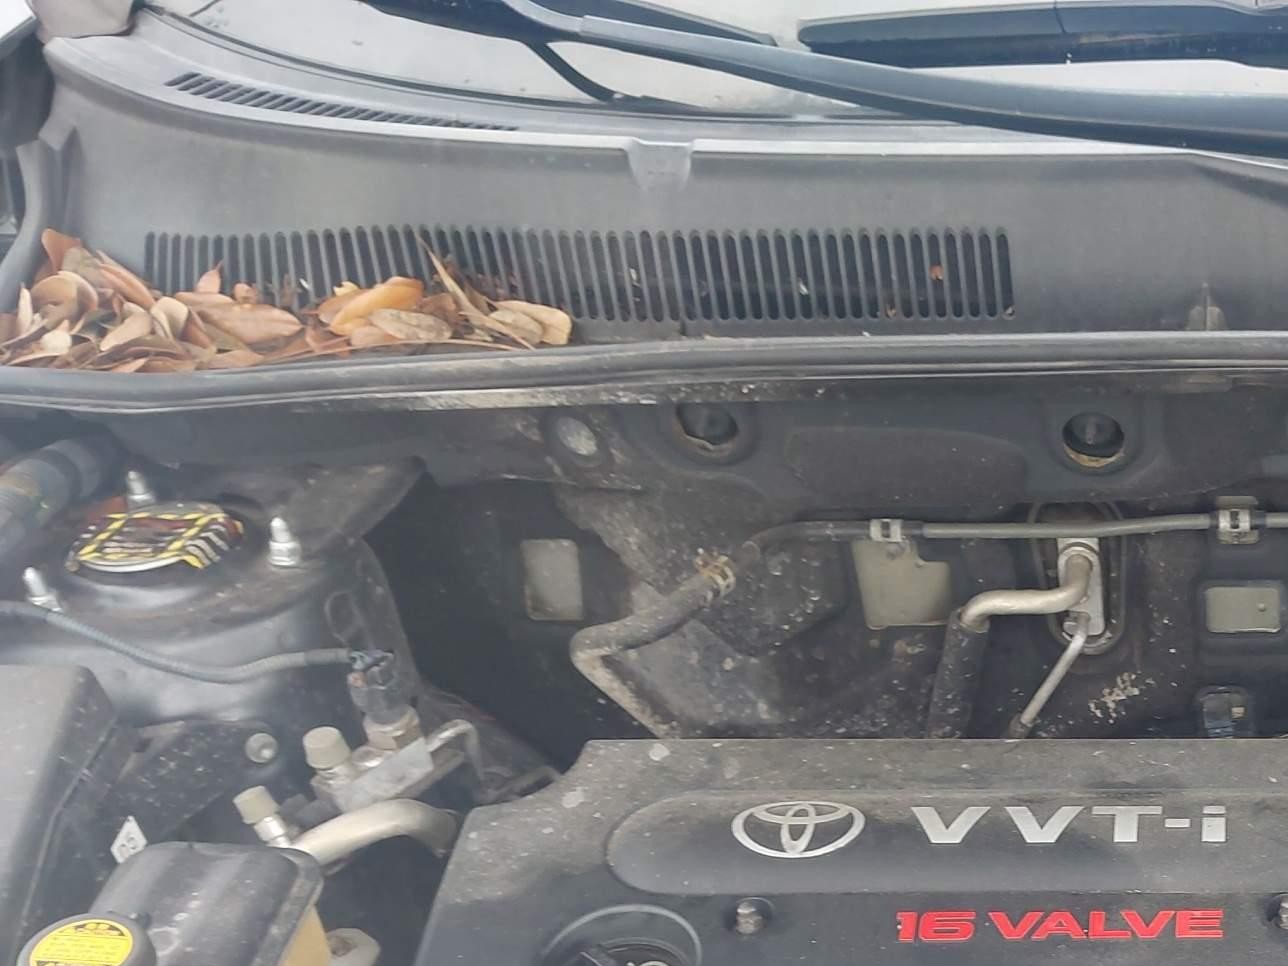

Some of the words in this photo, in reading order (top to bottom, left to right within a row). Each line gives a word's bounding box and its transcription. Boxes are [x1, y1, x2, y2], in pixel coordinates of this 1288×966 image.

[911, 805, 1227, 844] VVT-i
[896, 910, 976, 942] 16
[987, 910, 1224, 940] VALVE
